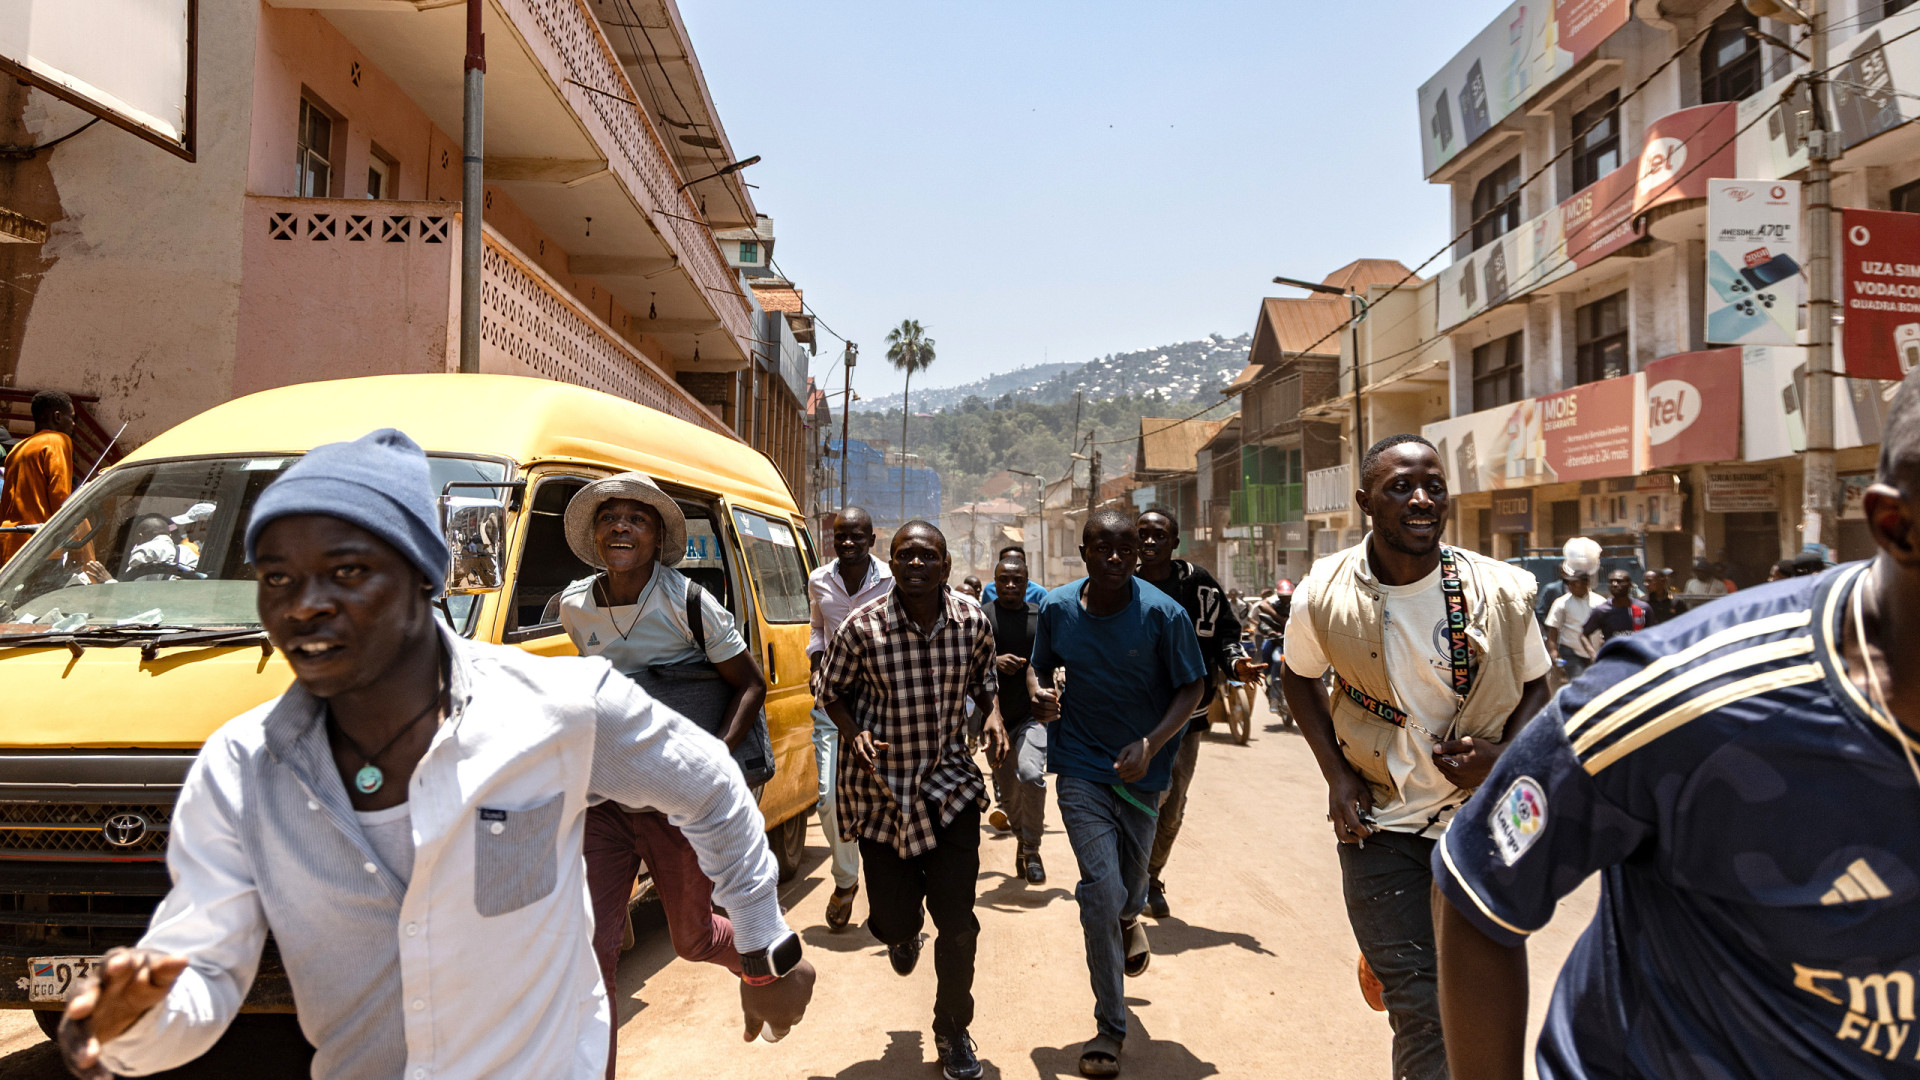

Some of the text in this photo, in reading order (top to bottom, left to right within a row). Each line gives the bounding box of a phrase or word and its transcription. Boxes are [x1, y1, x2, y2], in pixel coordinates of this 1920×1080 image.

[1861, 260, 1894, 276] UZA
[1854, 281, 1920, 298] VODACO
[1850, 299, 1897, 312] QUADRA
[1544, 394, 1578, 421] MOIS
[1650, 390, 1686, 427] itel
[1448, 595, 1465, 629] LOVE
[1452, 631, 1467, 665] LOVE
[1350, 687, 1377, 712] LOVE
[1378, 705, 1407, 727] LOVE
[34, 983, 55, 997] CGO
[1835, 1010, 1910, 1061] FLY
